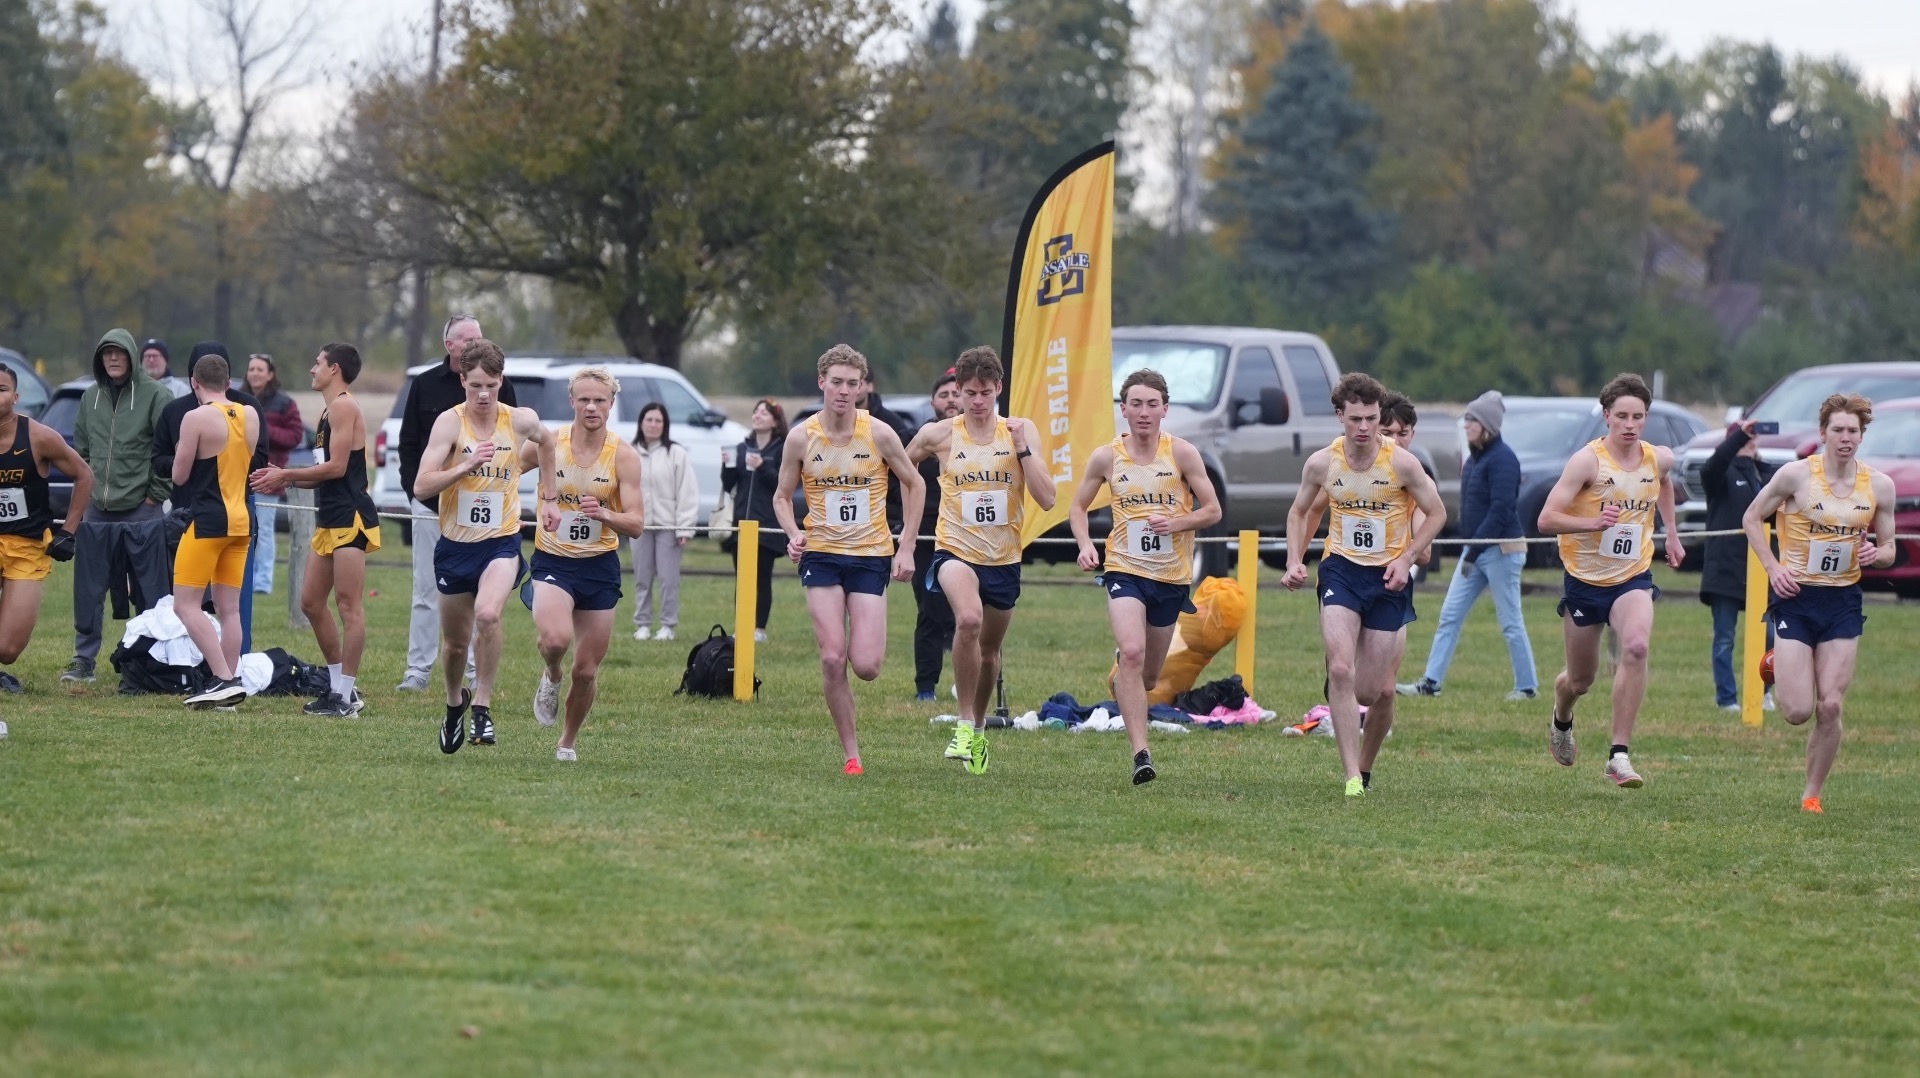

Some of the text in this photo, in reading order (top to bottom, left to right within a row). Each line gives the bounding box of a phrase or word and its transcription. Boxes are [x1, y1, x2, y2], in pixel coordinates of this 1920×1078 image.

[1046, 337, 1072, 484] LA SALLE
[0, 469, 24, 483] MS
[468, 466, 511, 480] SALLE
[955, 470, 1013, 486] LASALLE
[557, 493, 609, 509] ASAE
[1120, 493, 1176, 509] LASALLE
[0, 502, 18, 518] 39
[470, 507, 491, 524] 63
[839, 505, 857, 521] 67
[975, 506, 996, 522] 65
[570, 525, 590, 540] 59
[1353, 531, 1373, 548] 68
[1141, 535, 1161, 552] 64
[1612, 538, 1633, 555] 60
[1820, 556, 1840, 571] 61
